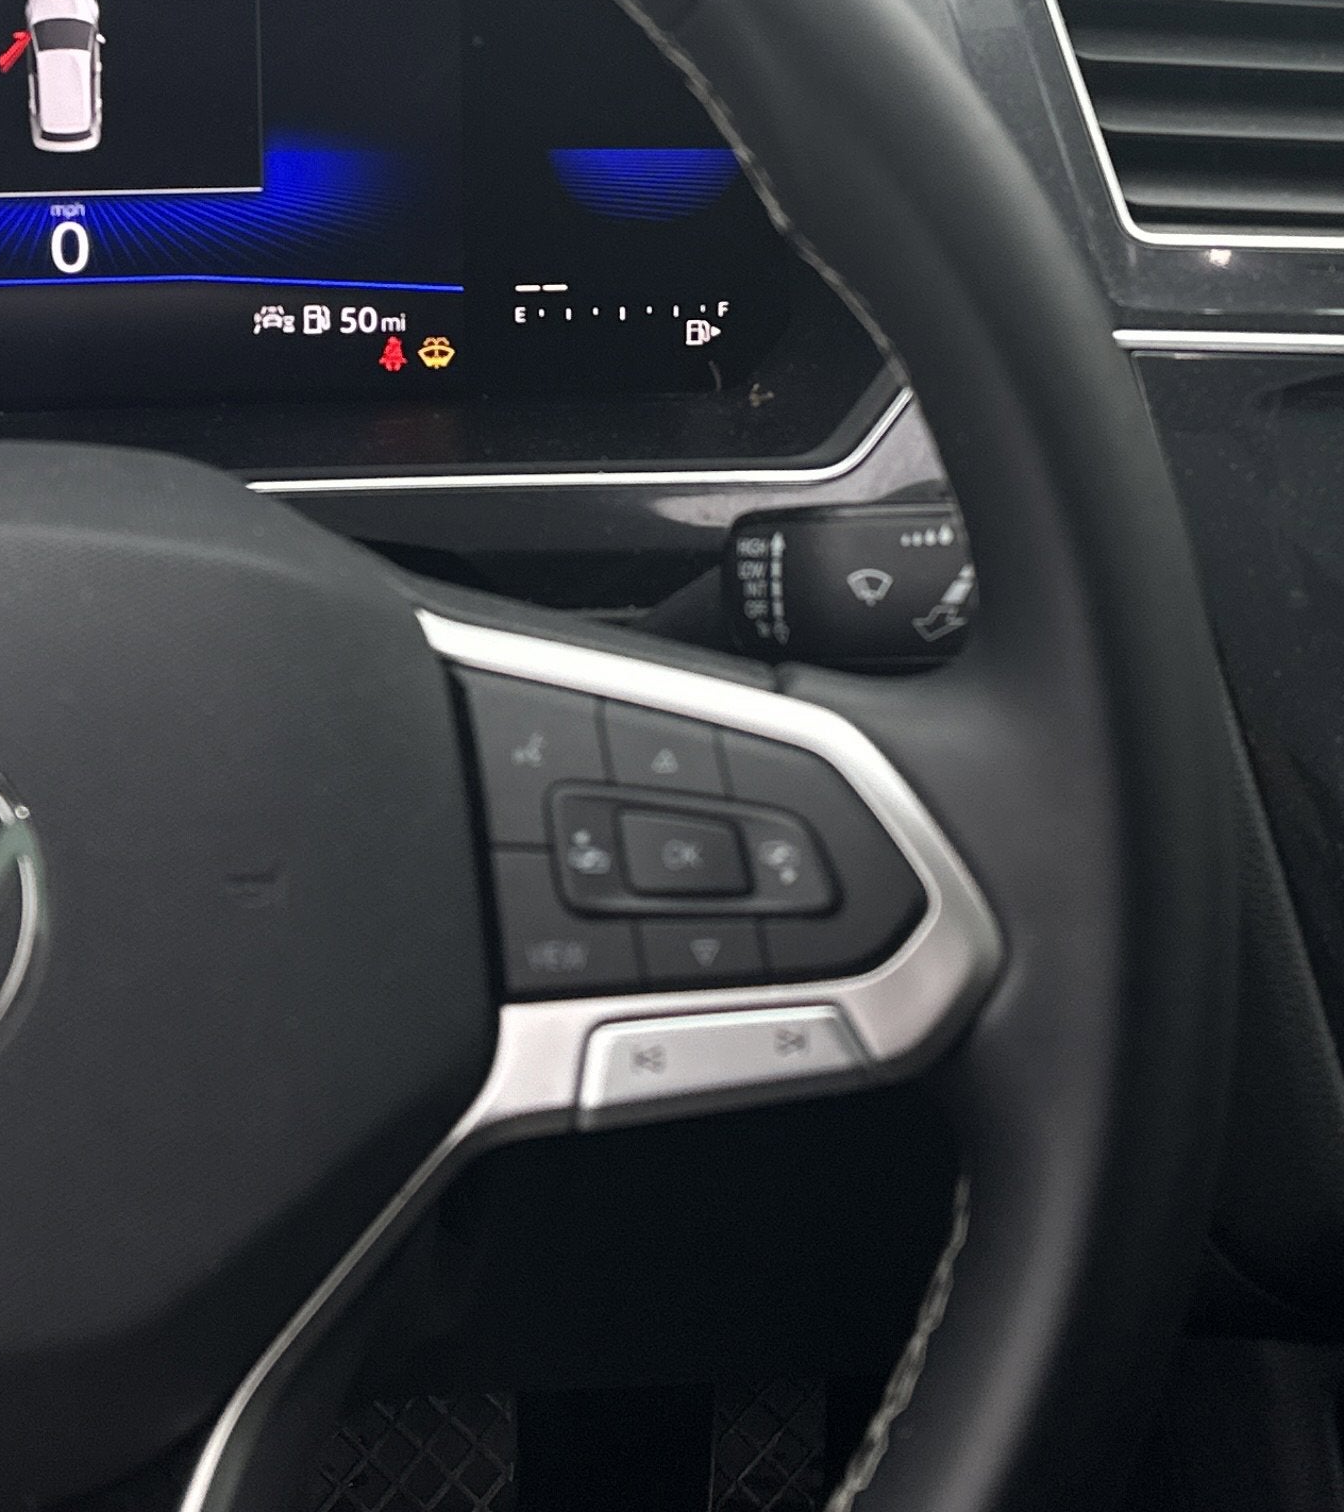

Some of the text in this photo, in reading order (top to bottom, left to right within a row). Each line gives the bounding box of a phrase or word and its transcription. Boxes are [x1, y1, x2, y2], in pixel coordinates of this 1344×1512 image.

[51, 221, 89, 274] 0
[514, 306, 527, 323] E
[717, 302, 729, 319] F
